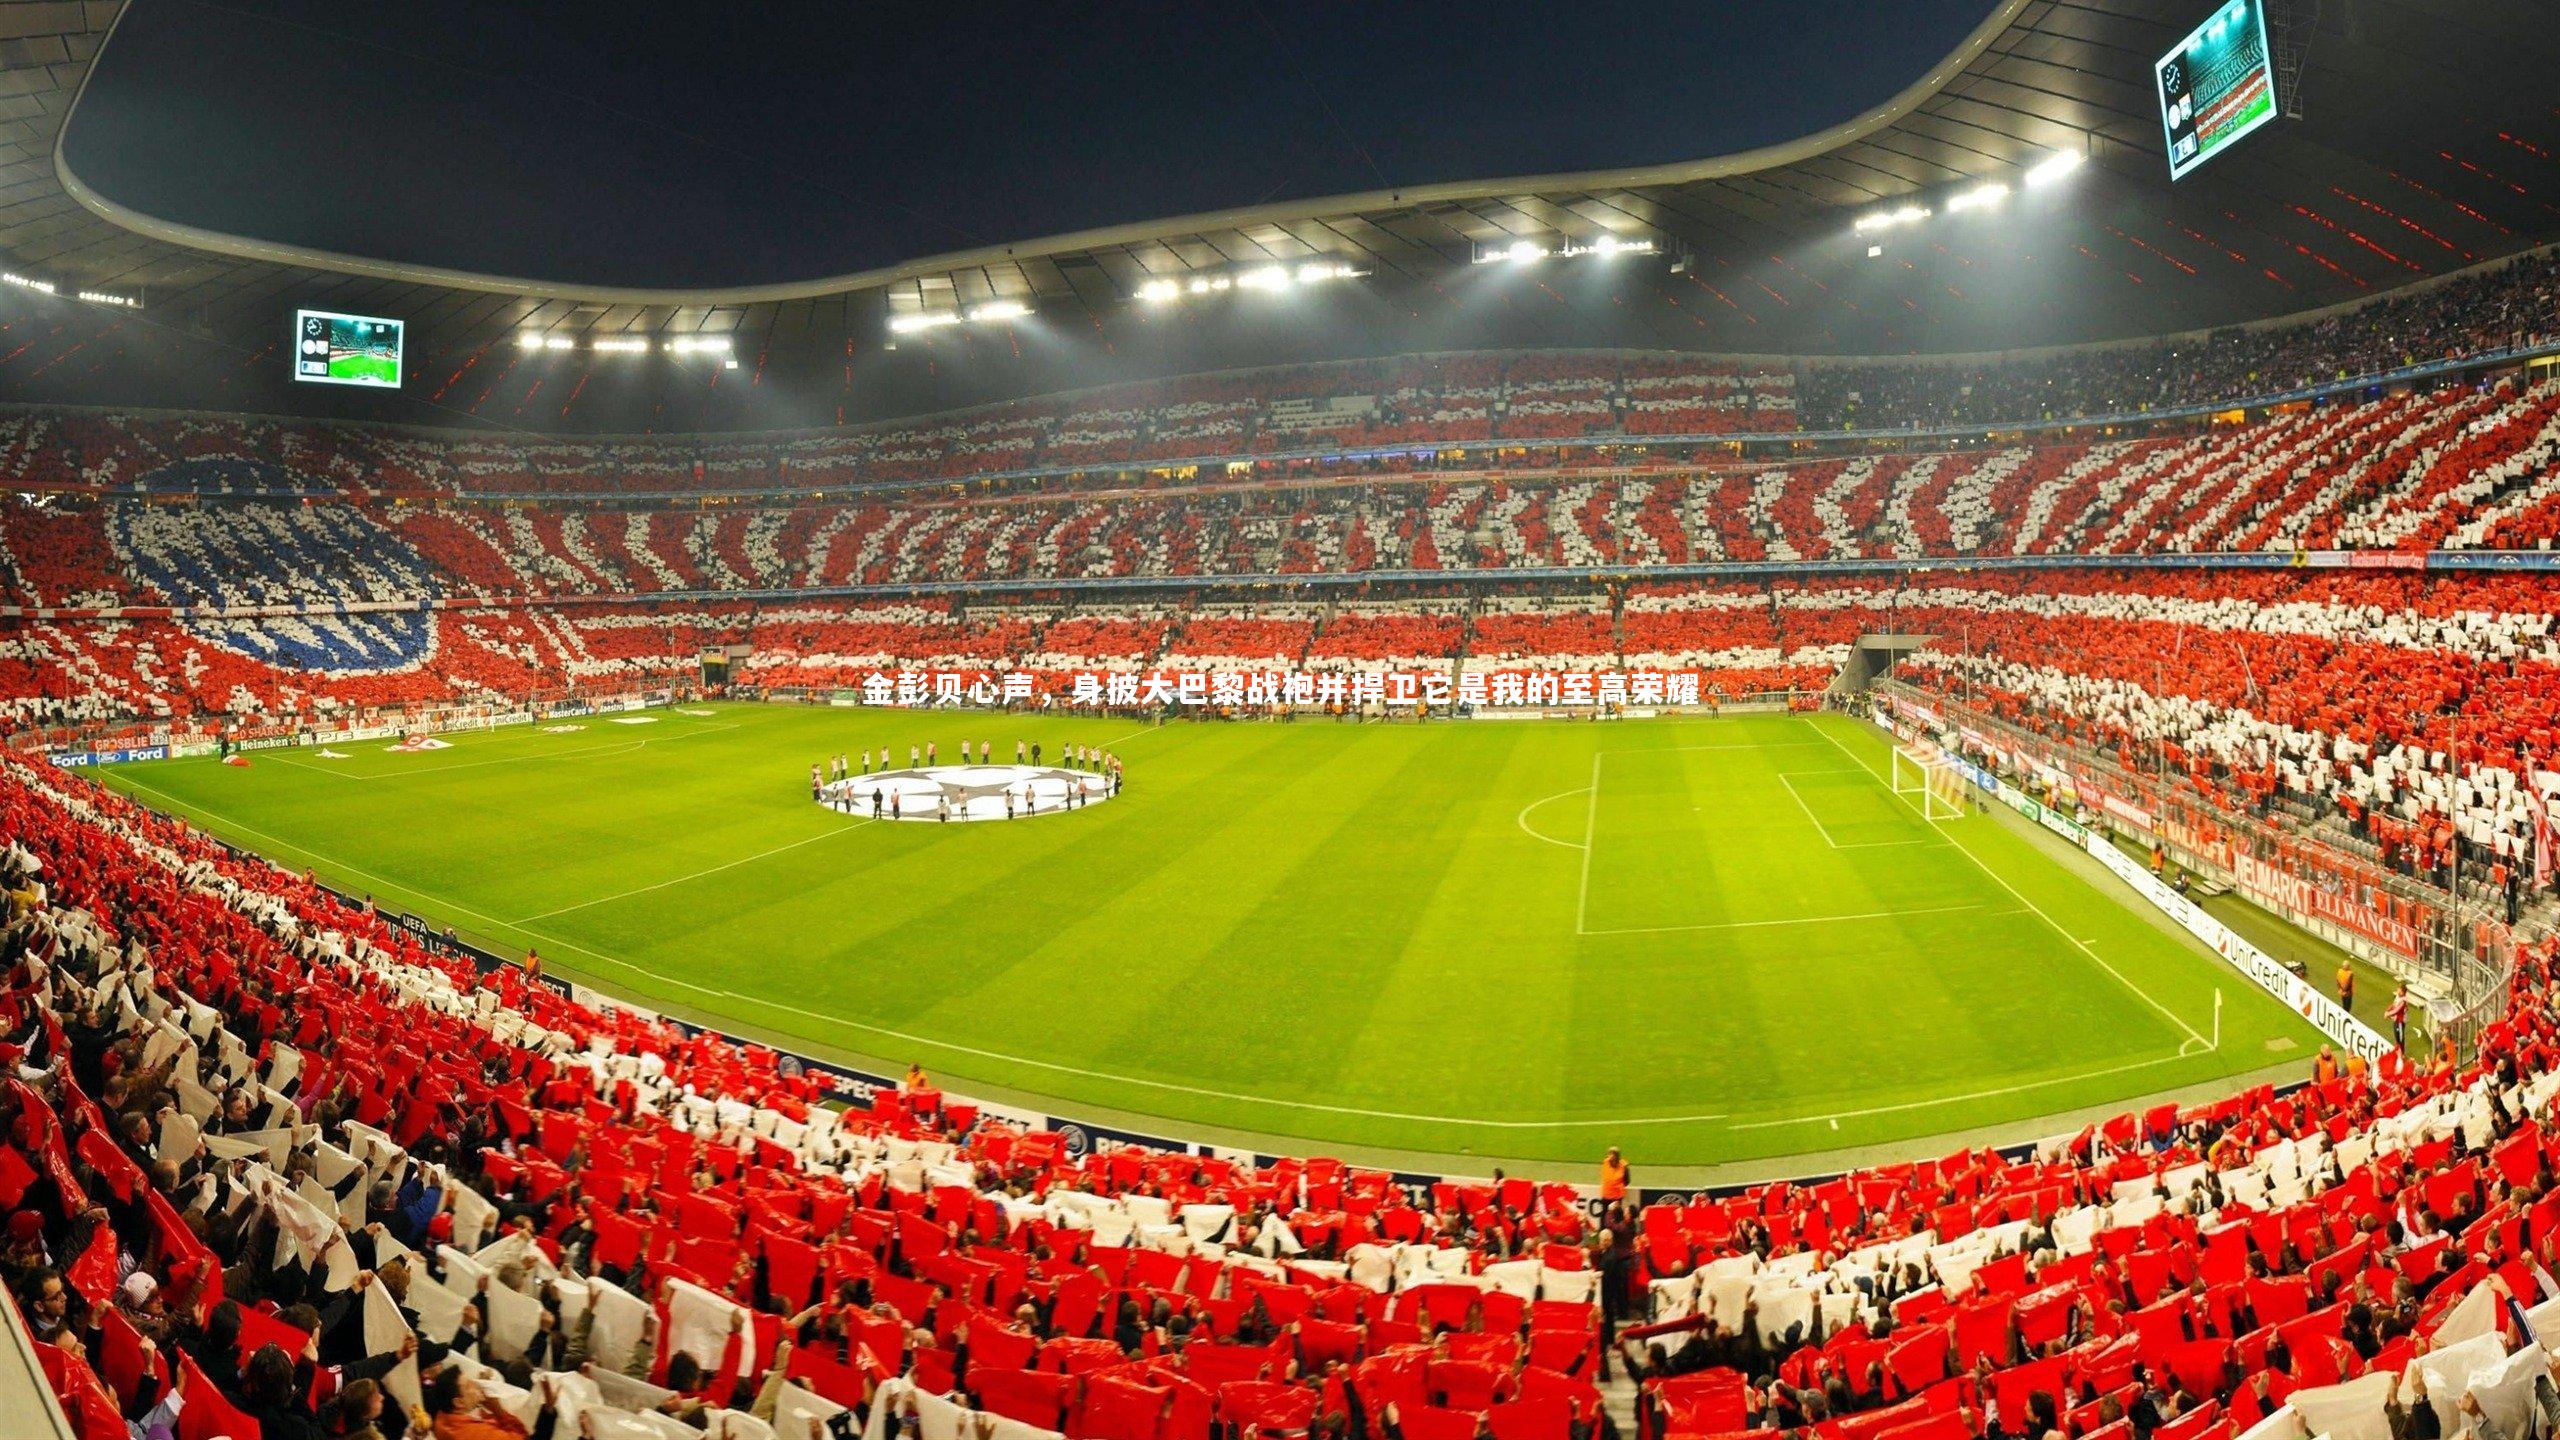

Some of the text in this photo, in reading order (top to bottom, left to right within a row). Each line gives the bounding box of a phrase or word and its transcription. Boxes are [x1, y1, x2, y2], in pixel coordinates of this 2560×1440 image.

[548, 707, 586, 719] MasterCard
[240, 737, 288, 751] Heineken
[52, 754, 88, 768] Ford
[128, 747, 163, 761] Ford
[2234, 852, 2311, 914] NEUMARKT
[402, 915, 427, 934] UEFA
[2315, 888, 2416, 953] ELLWANGEN
[2230, 936, 2289, 1000] UniCredit
